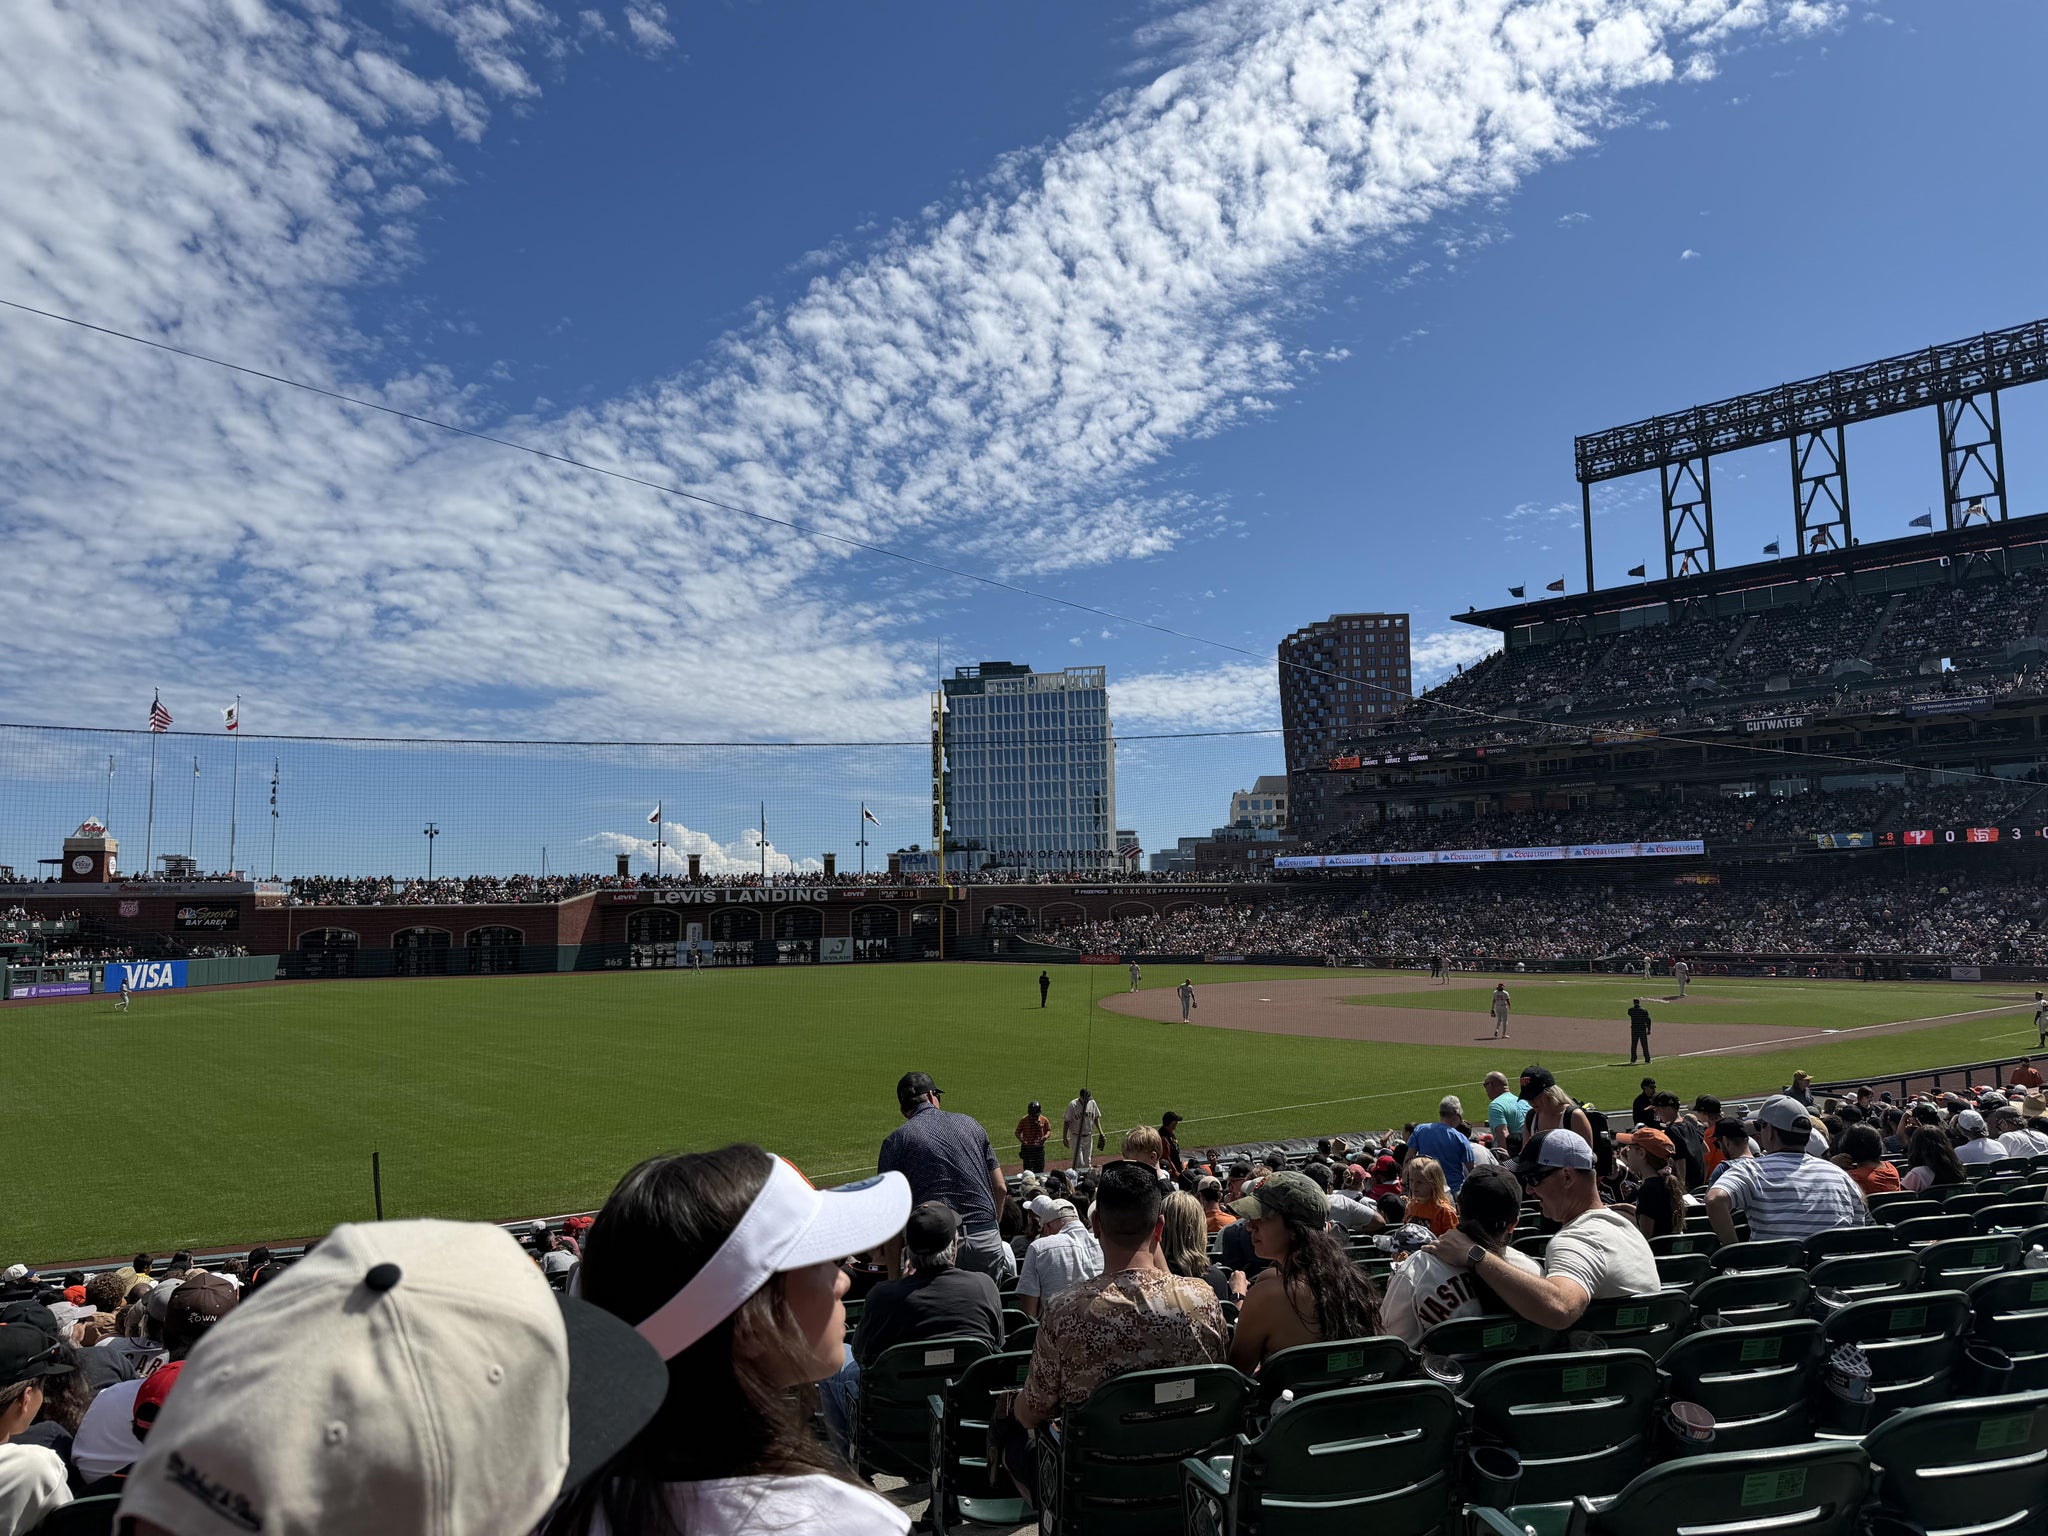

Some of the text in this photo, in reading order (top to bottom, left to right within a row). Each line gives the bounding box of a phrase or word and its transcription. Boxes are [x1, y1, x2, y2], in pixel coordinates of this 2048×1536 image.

[1746, 717, 1803, 732] CUTWATER
[1886, 832, 1894, 841] 8
[1945, 830, 1955, 842] 0
[2011, 828, 2021, 840] 3
[999, 850, 1114, 859] BANK OF AMERICA
[1514, 849, 1552, 859] Coors LIGHT
[1582, 847, 1604, 857] Coors
[1656, 845, 1701, 854] Coors LIGHT
[901, 855, 928, 865] VISA
[1335, 856, 1351, 865] Coors
[1390, 854, 1408, 863] Coors
[1450, 852, 1469, 861] Coors
[1283, 858, 1300, 866] Coors
[725, 889, 829, 903] LANDING
[195, 907, 237, 921] Sports
[924, 950, 940, 958] 309
[122, 963, 174, 990] VISA
